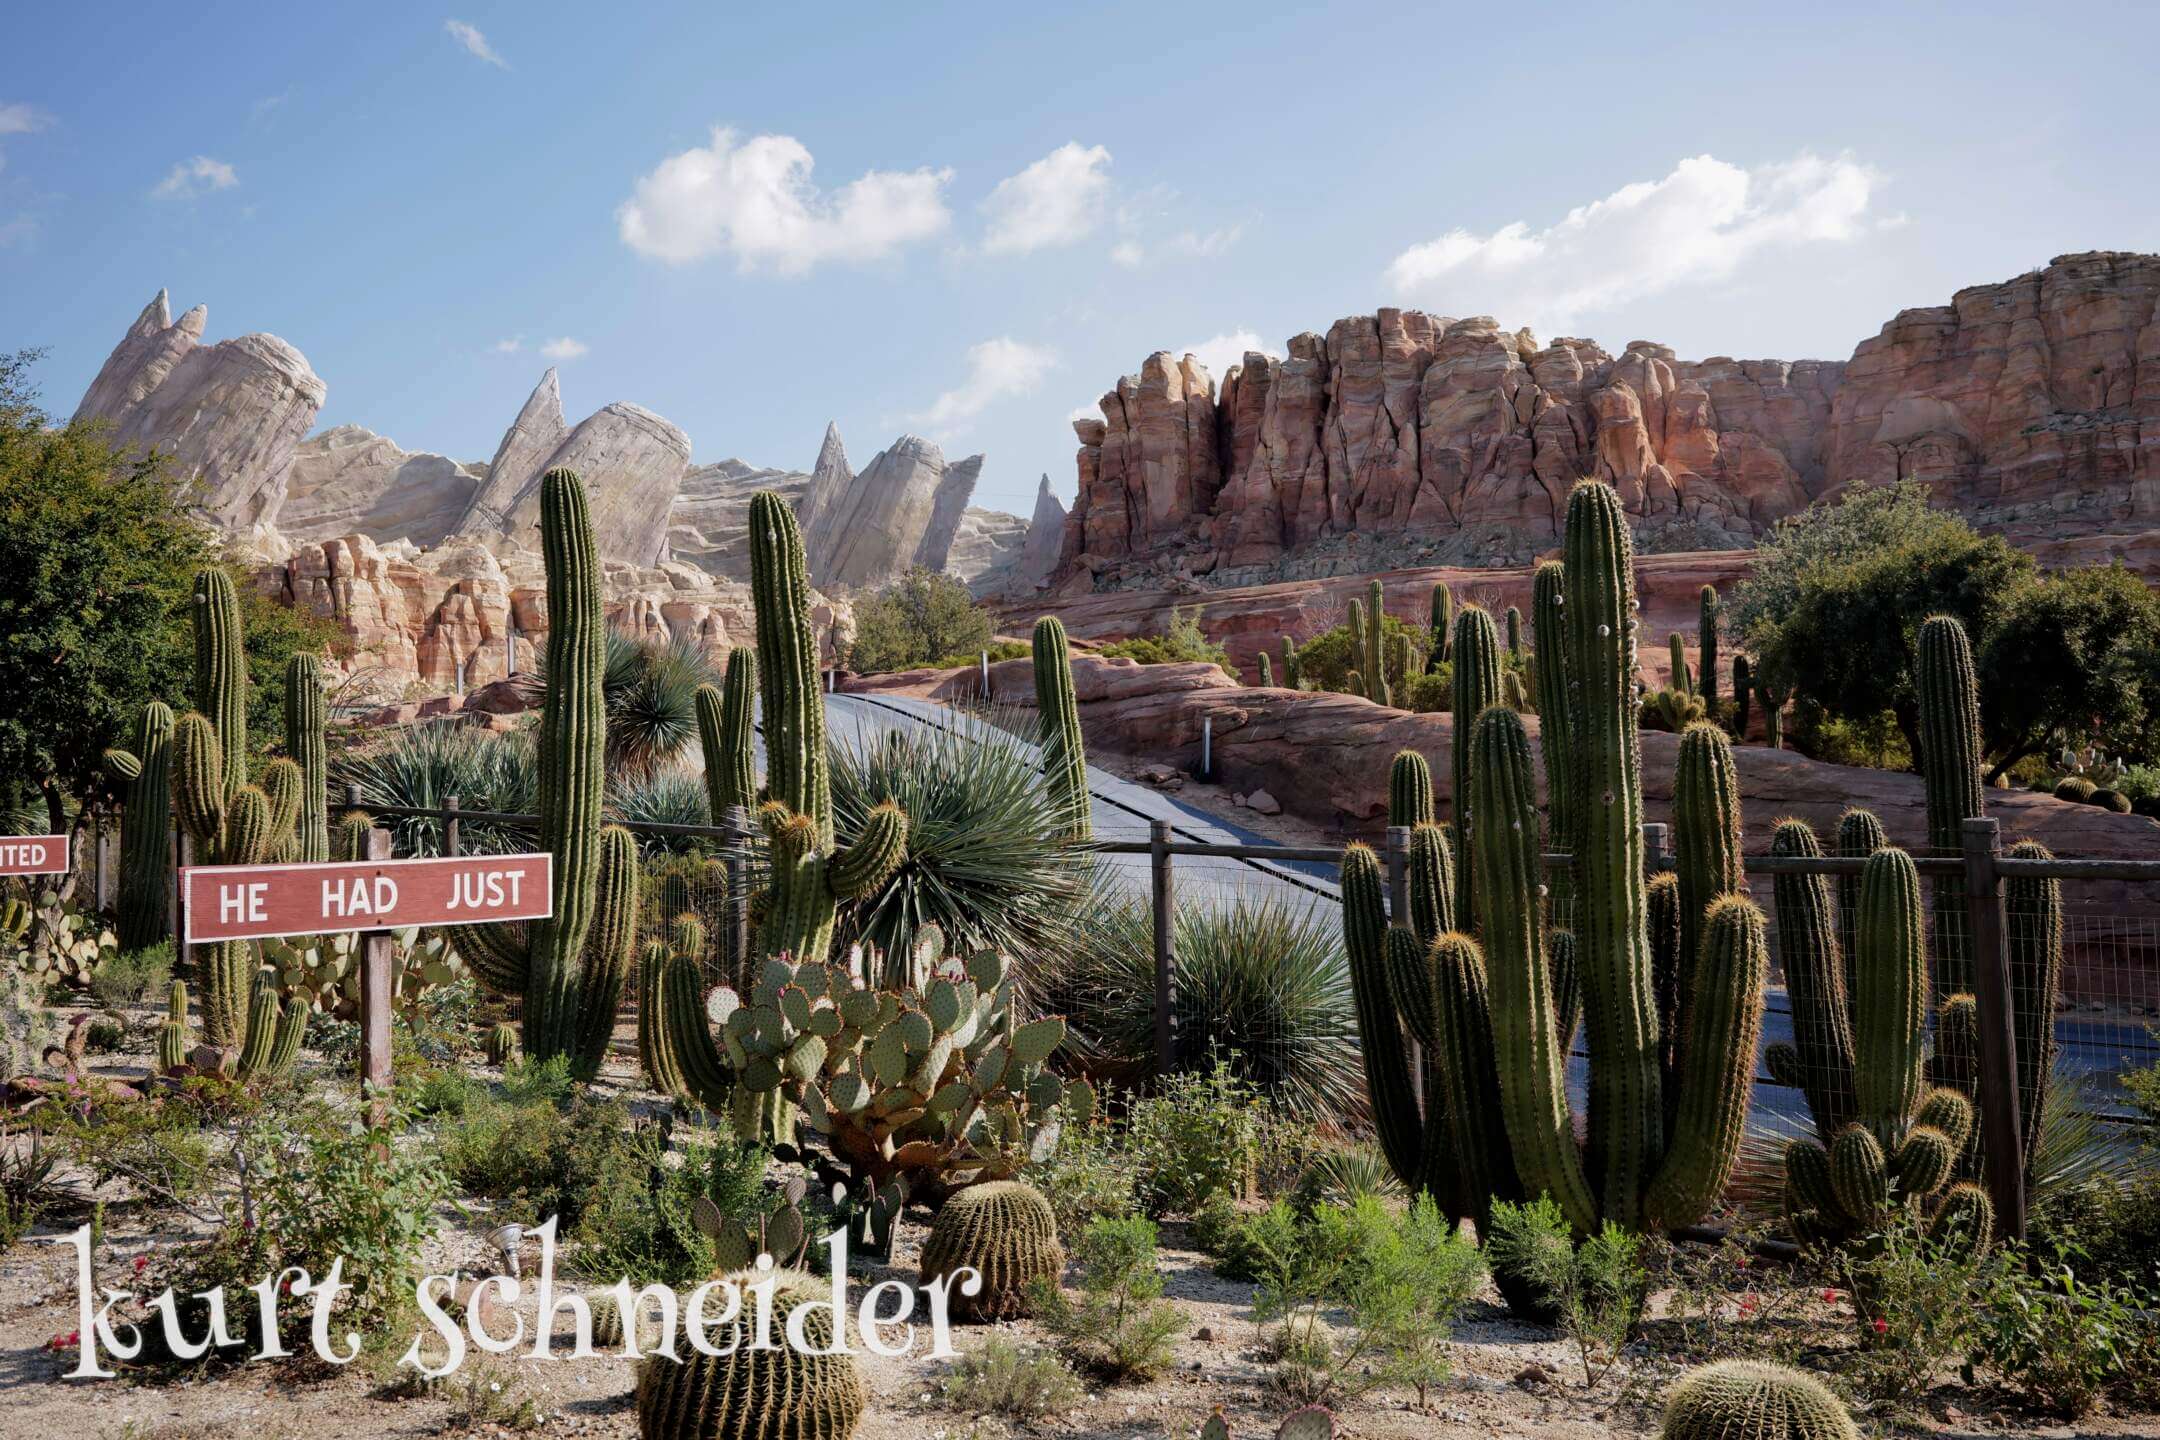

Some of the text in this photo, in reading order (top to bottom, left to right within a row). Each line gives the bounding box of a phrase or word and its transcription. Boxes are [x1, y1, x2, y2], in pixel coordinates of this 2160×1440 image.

[220, 870, 526, 924] HE HAD JUST
